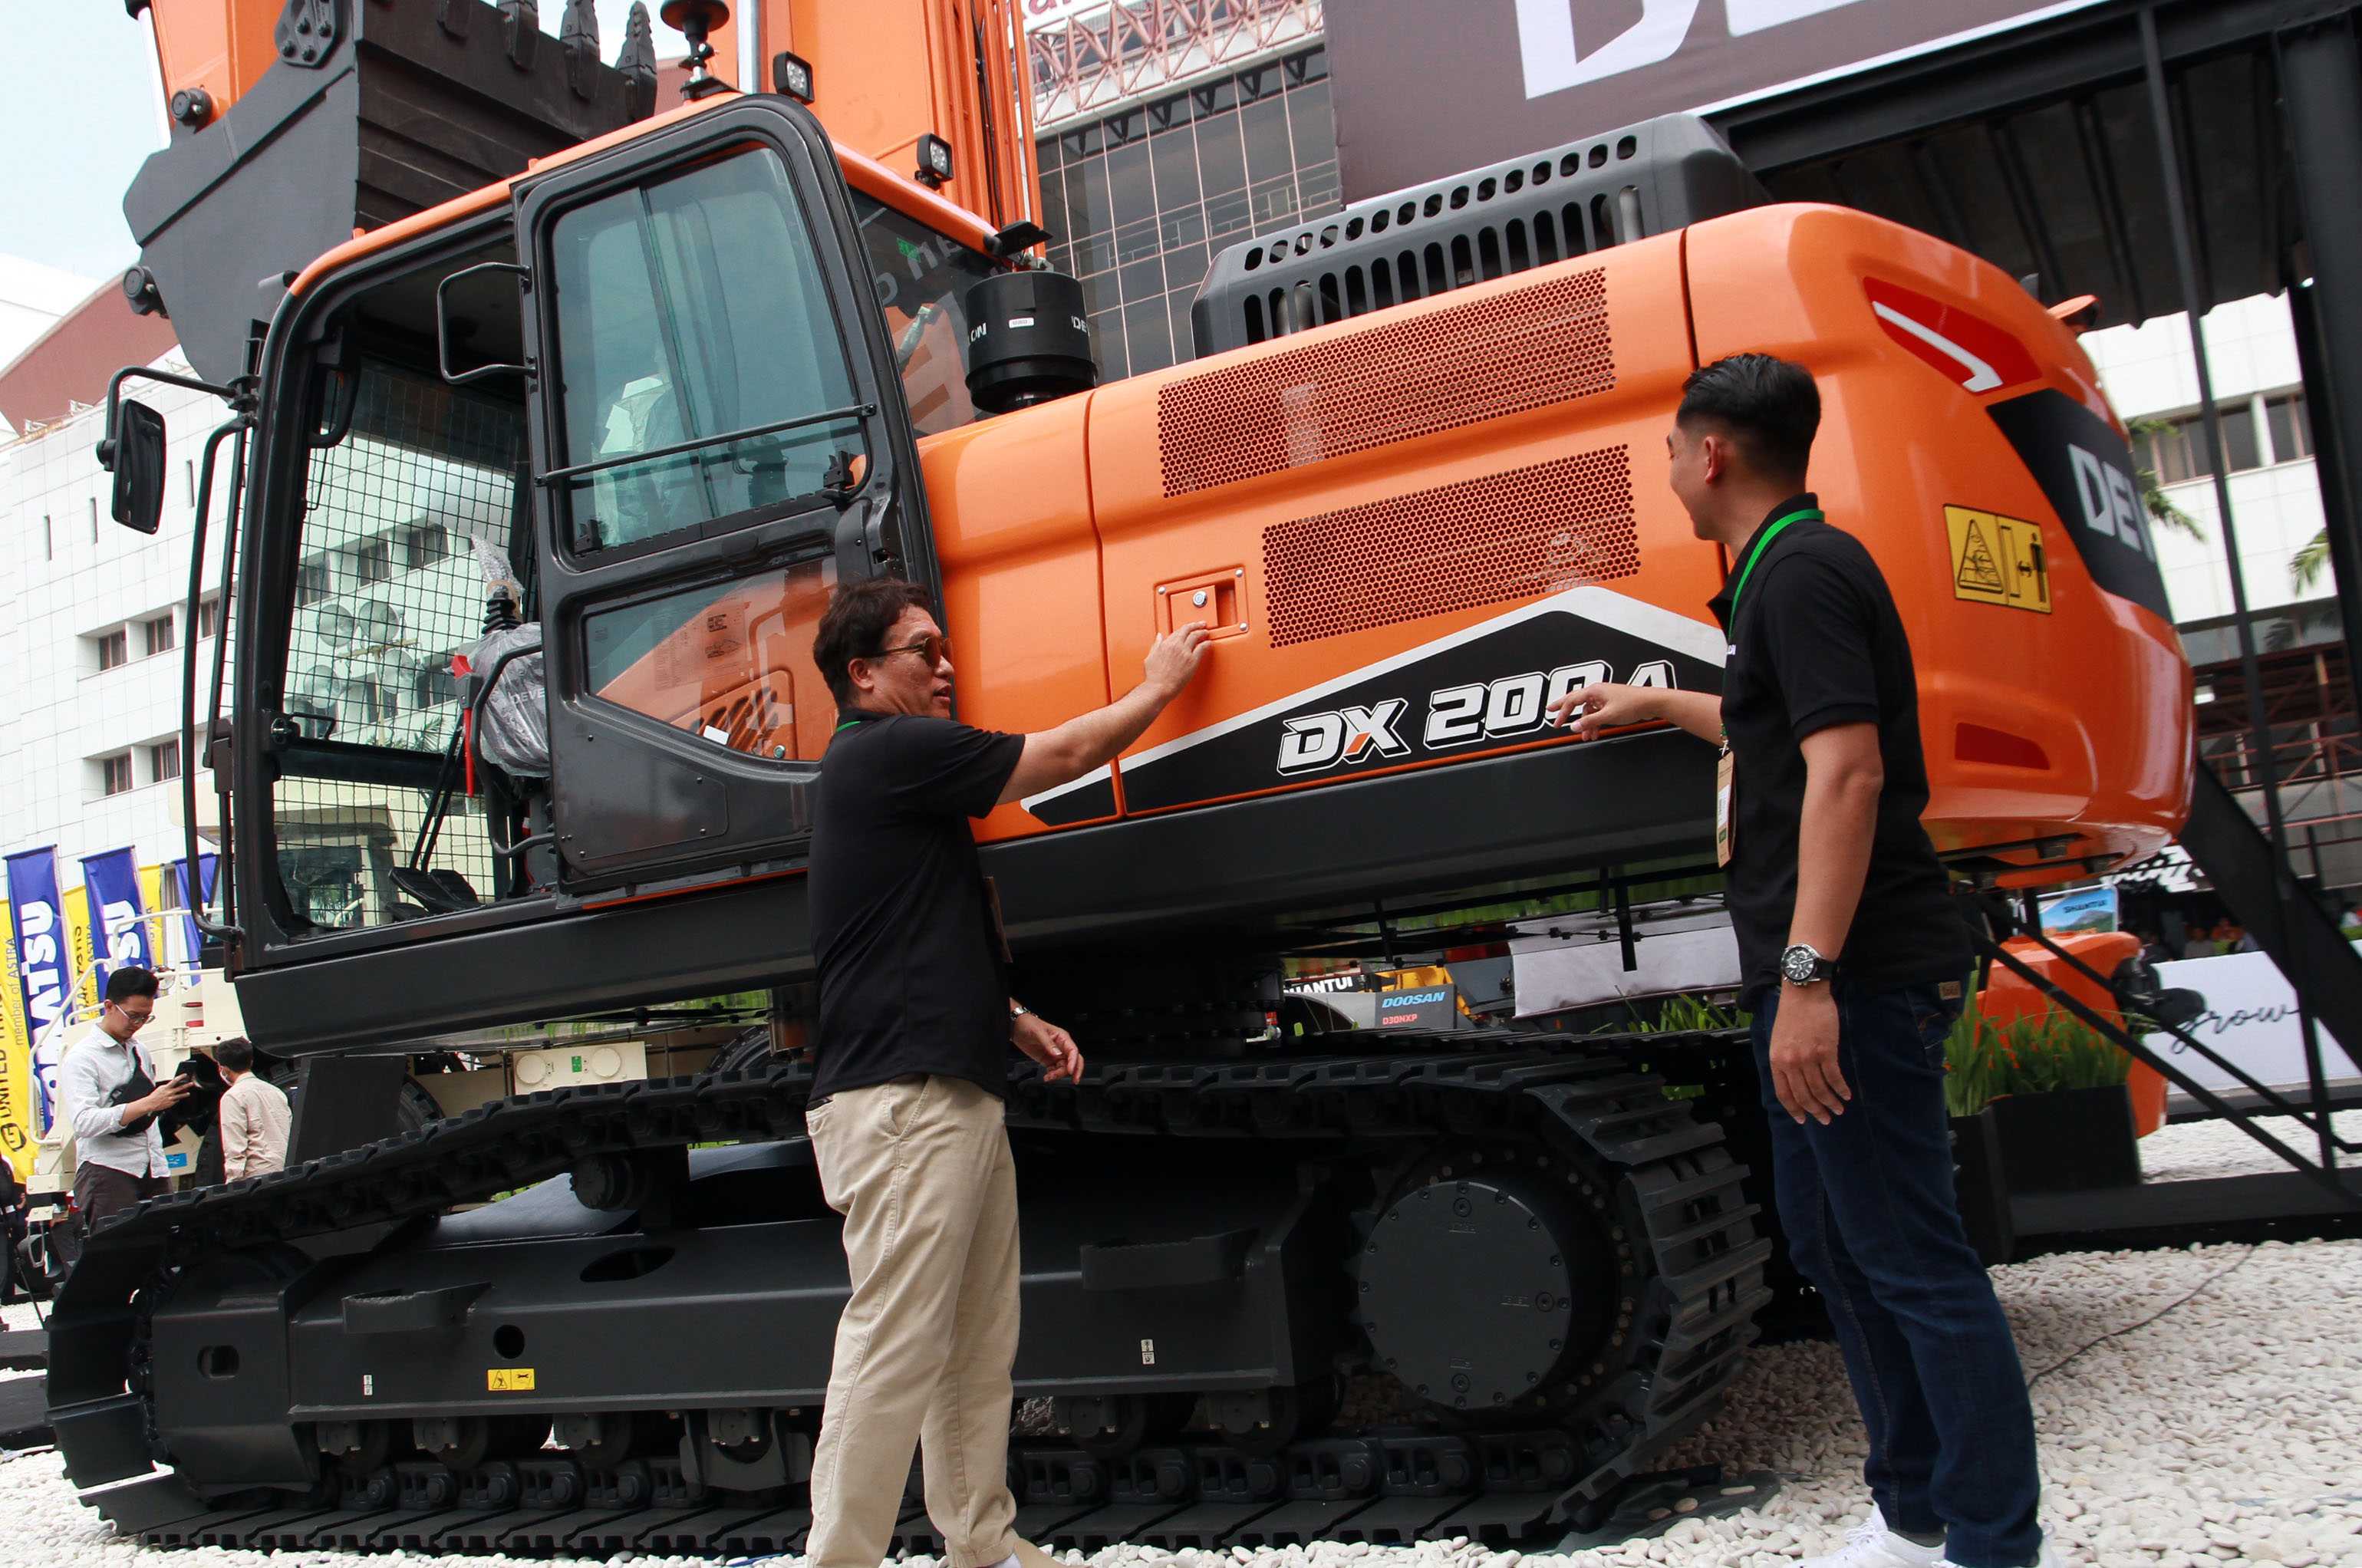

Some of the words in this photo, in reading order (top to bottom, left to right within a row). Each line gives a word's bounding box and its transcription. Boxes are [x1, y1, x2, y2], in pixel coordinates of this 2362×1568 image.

[1277, 698, 1410, 776] DX
[5, 937, 18, 978] ASTRA
[8, 983, 20, 998] of
[1283, 976, 1352, 993] ANTUI
[1382, 992, 1445, 1007] DOOSAN
[10, 1006, 24, 1046] member
[21, 901, 64, 1117] OMATSU
